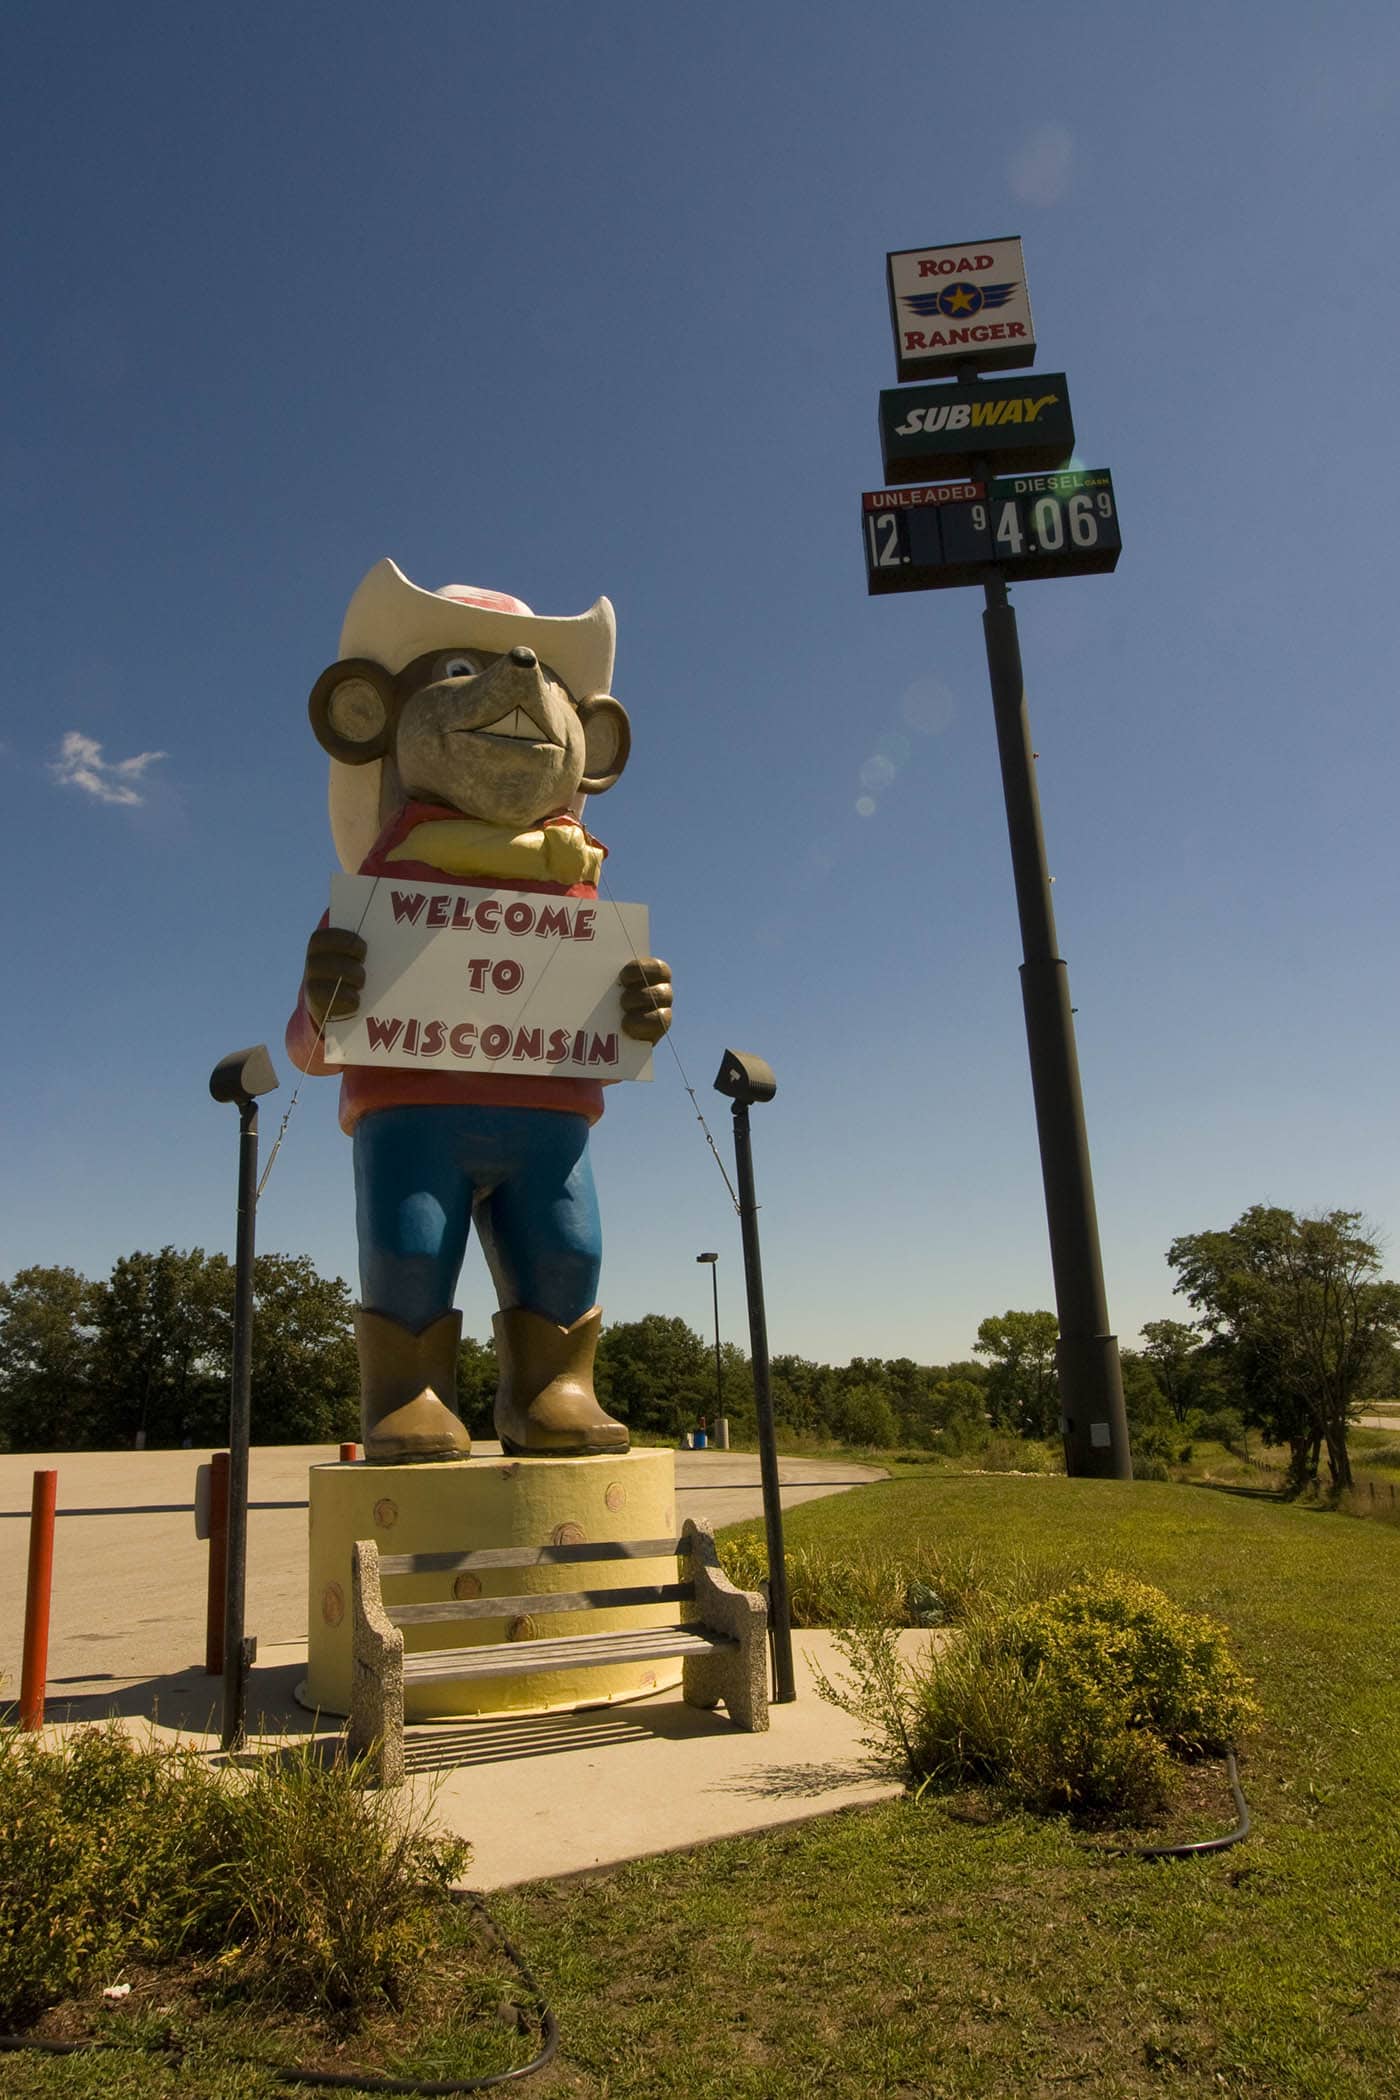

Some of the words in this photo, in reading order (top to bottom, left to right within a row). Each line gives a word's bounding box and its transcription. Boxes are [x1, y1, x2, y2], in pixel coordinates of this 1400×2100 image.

[917, 255, 994, 278] ROAD
[904, 321, 1027, 351] RANGER
[895, 394, 1059, 436] SUBWAY
[872, 486, 977, 508] UNLEADED
[1015, 475, 1084, 494] DIESEL
[389, 890, 597, 942] WELCOME
[467, 959, 525, 995] TO
[365, 1016, 619, 1066] WISCONSIN
